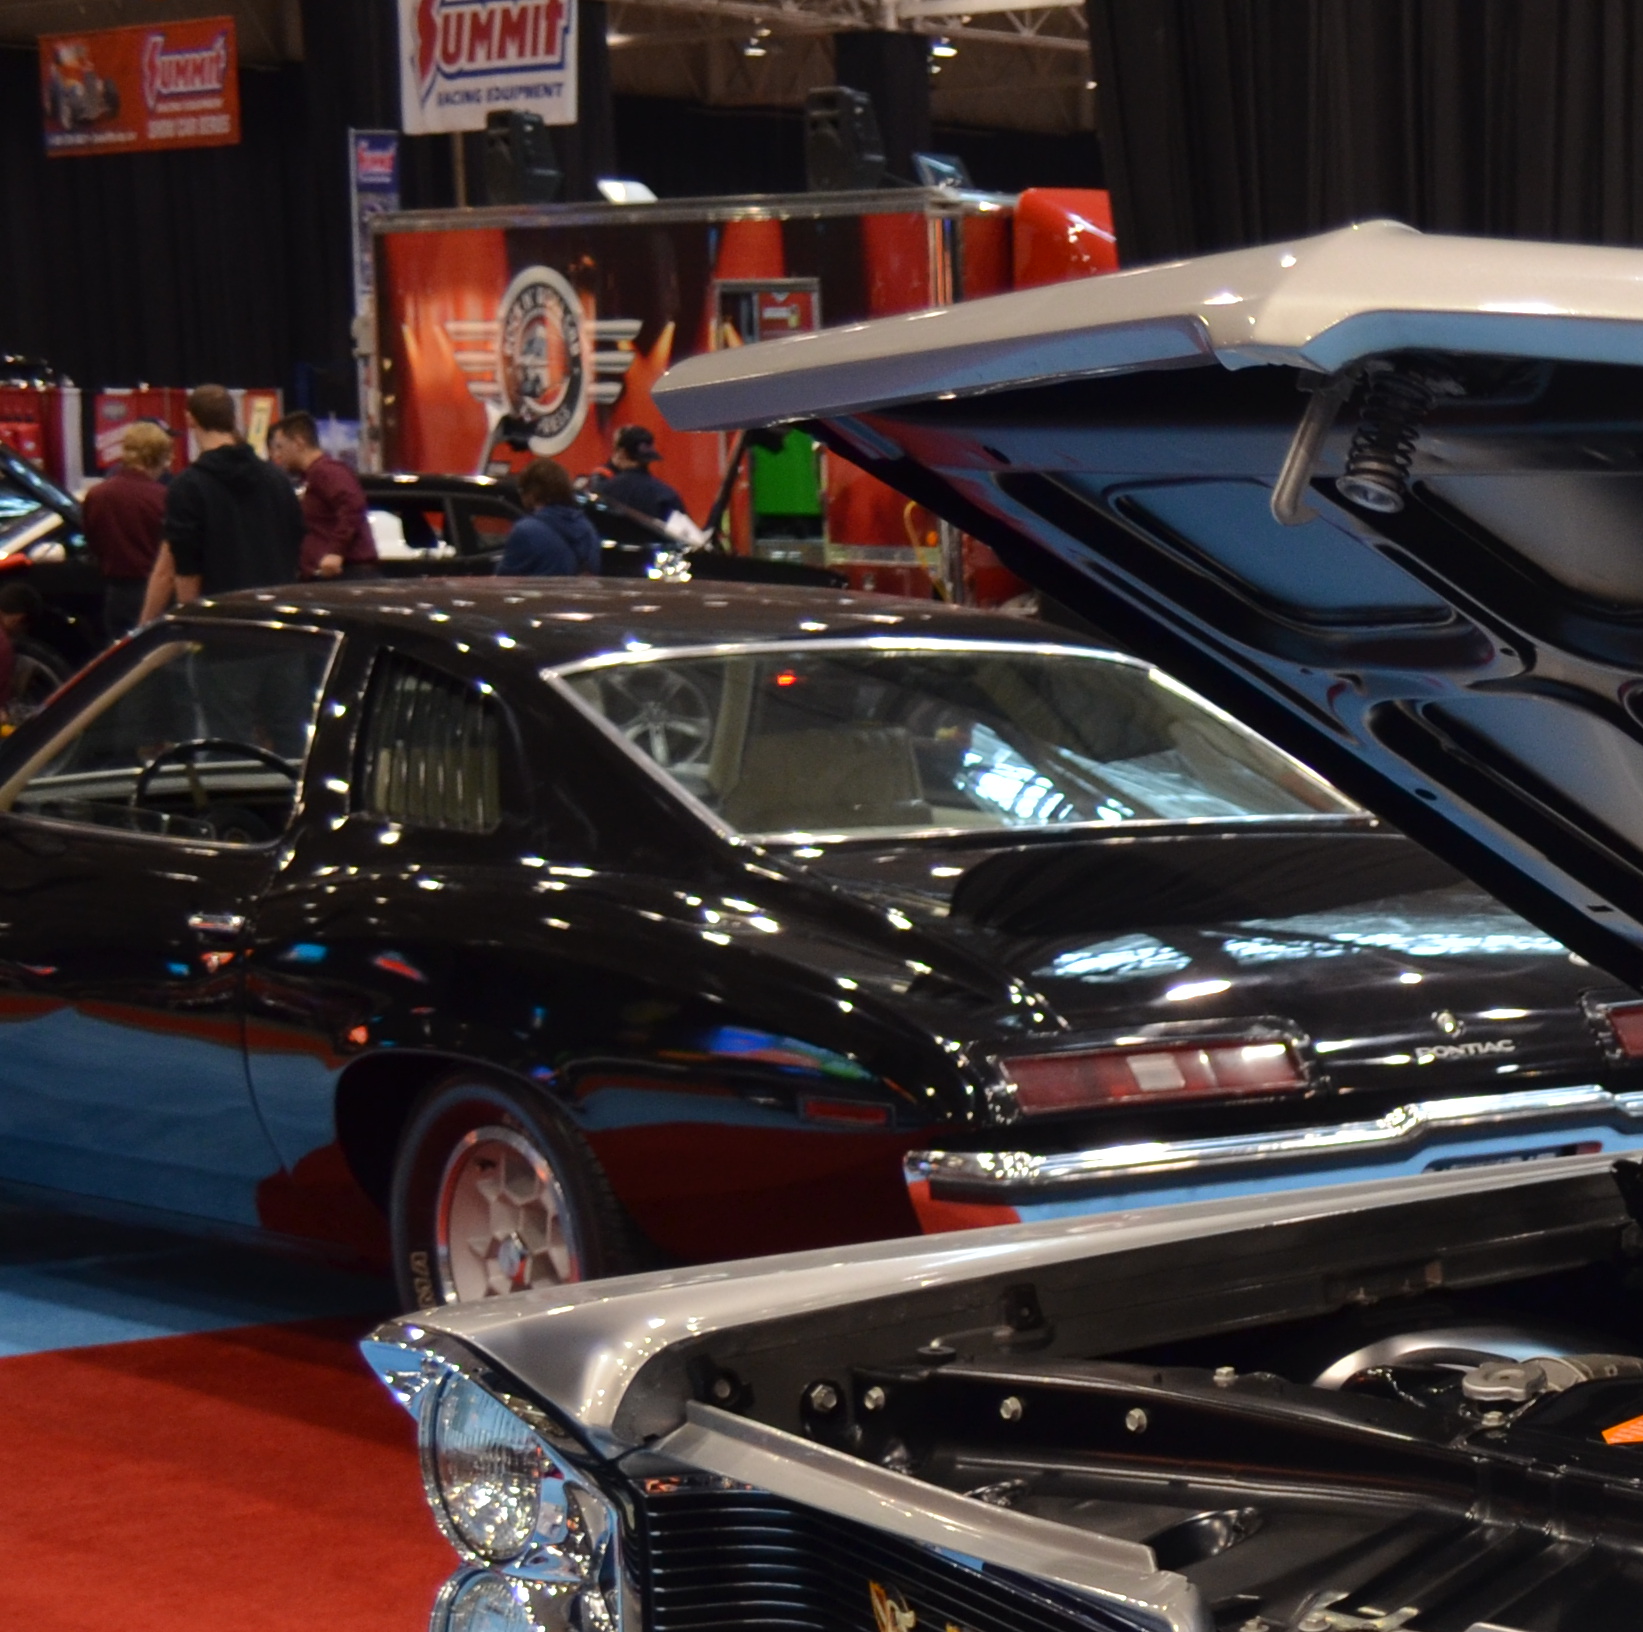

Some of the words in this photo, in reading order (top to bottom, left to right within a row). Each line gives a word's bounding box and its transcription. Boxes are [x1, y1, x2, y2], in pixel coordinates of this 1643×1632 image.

[417, 0, 564, 84] SUMMIT
[487, 82, 564, 101] EQUIPMENT
[1415, 1039, 1516, 1060] PONTIAC
